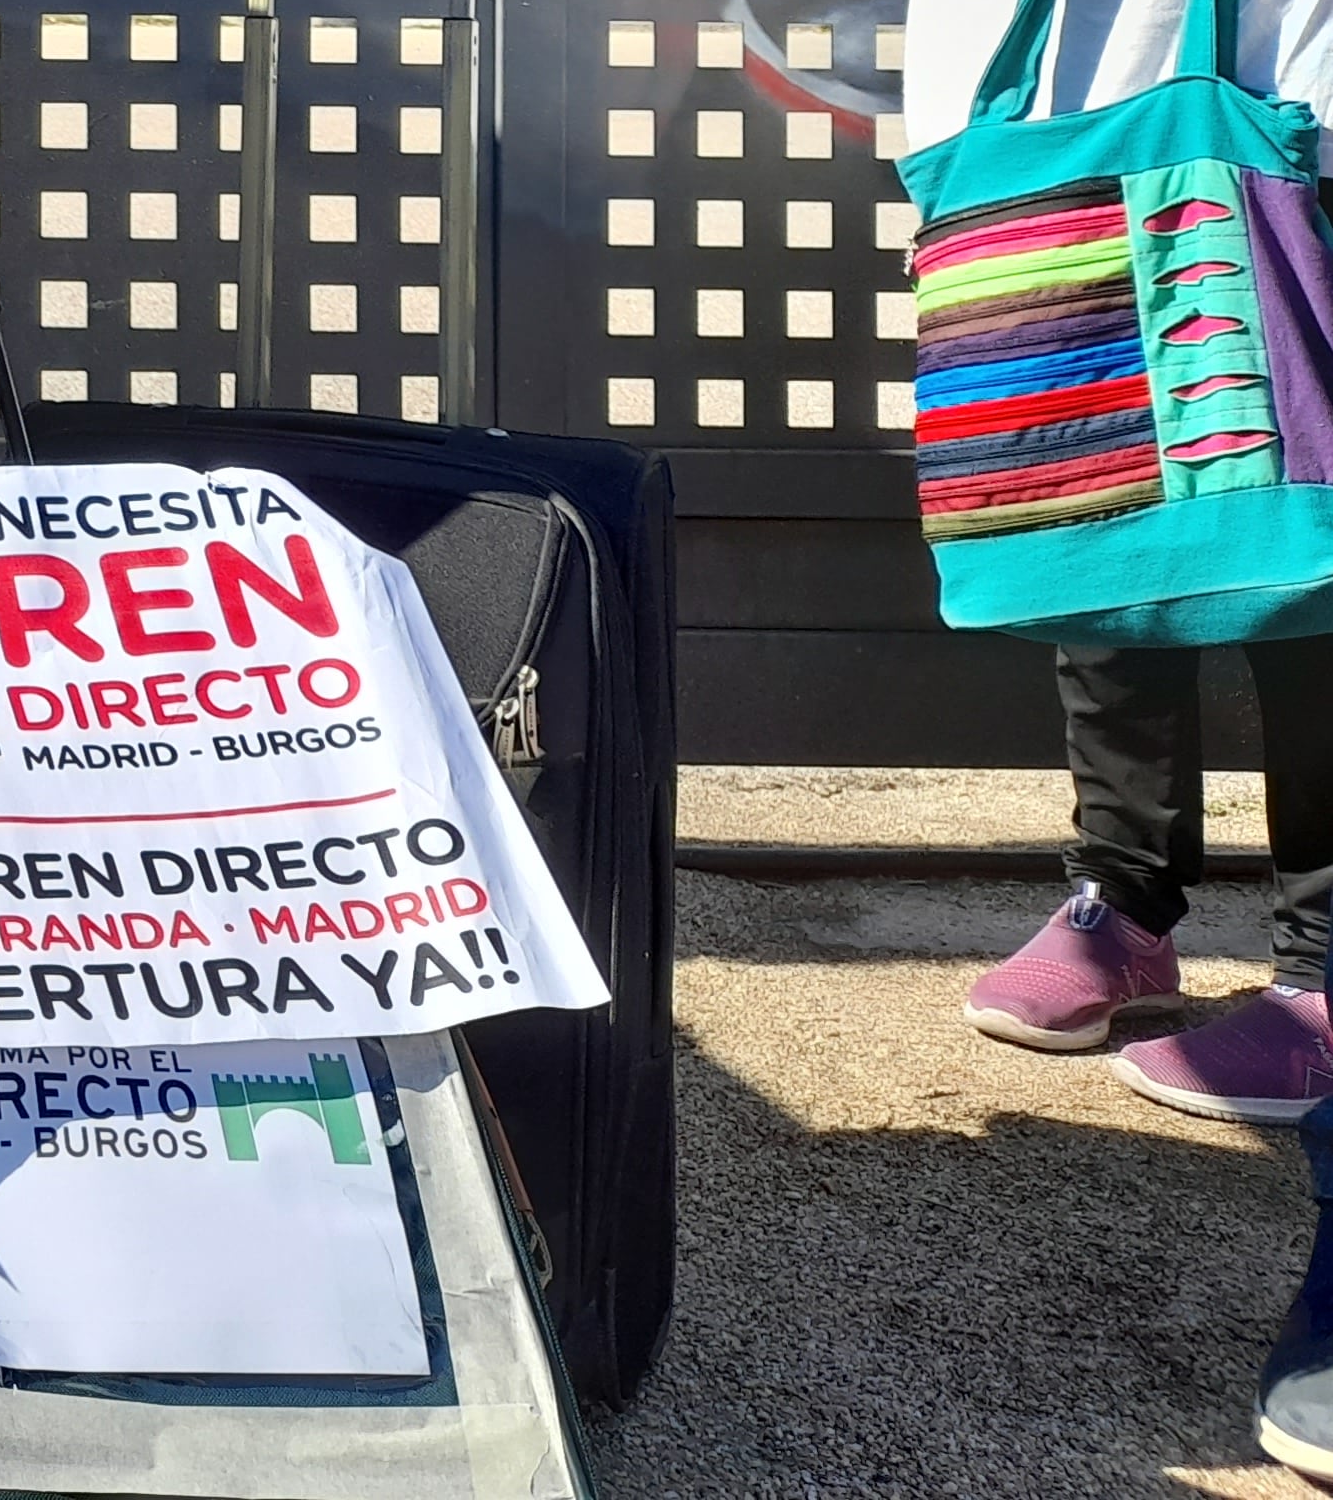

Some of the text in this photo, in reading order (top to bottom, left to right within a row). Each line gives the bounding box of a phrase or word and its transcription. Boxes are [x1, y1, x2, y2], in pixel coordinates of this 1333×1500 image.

[5, 657, 362, 733] DIRECTO
[22, 739, 177, 772] MADRID
[213, 716, 384, 765] BURGOS
[142, 817, 467, 897] DIRECTO
[253, 876, 490, 944] MADRID
[339, 926, 521, 1012] YA!!
[68, 1046, 133, 1071] POR
[149, 1050, 193, 1074] EL
[35, 1126, 209, 1161] BURGOS
